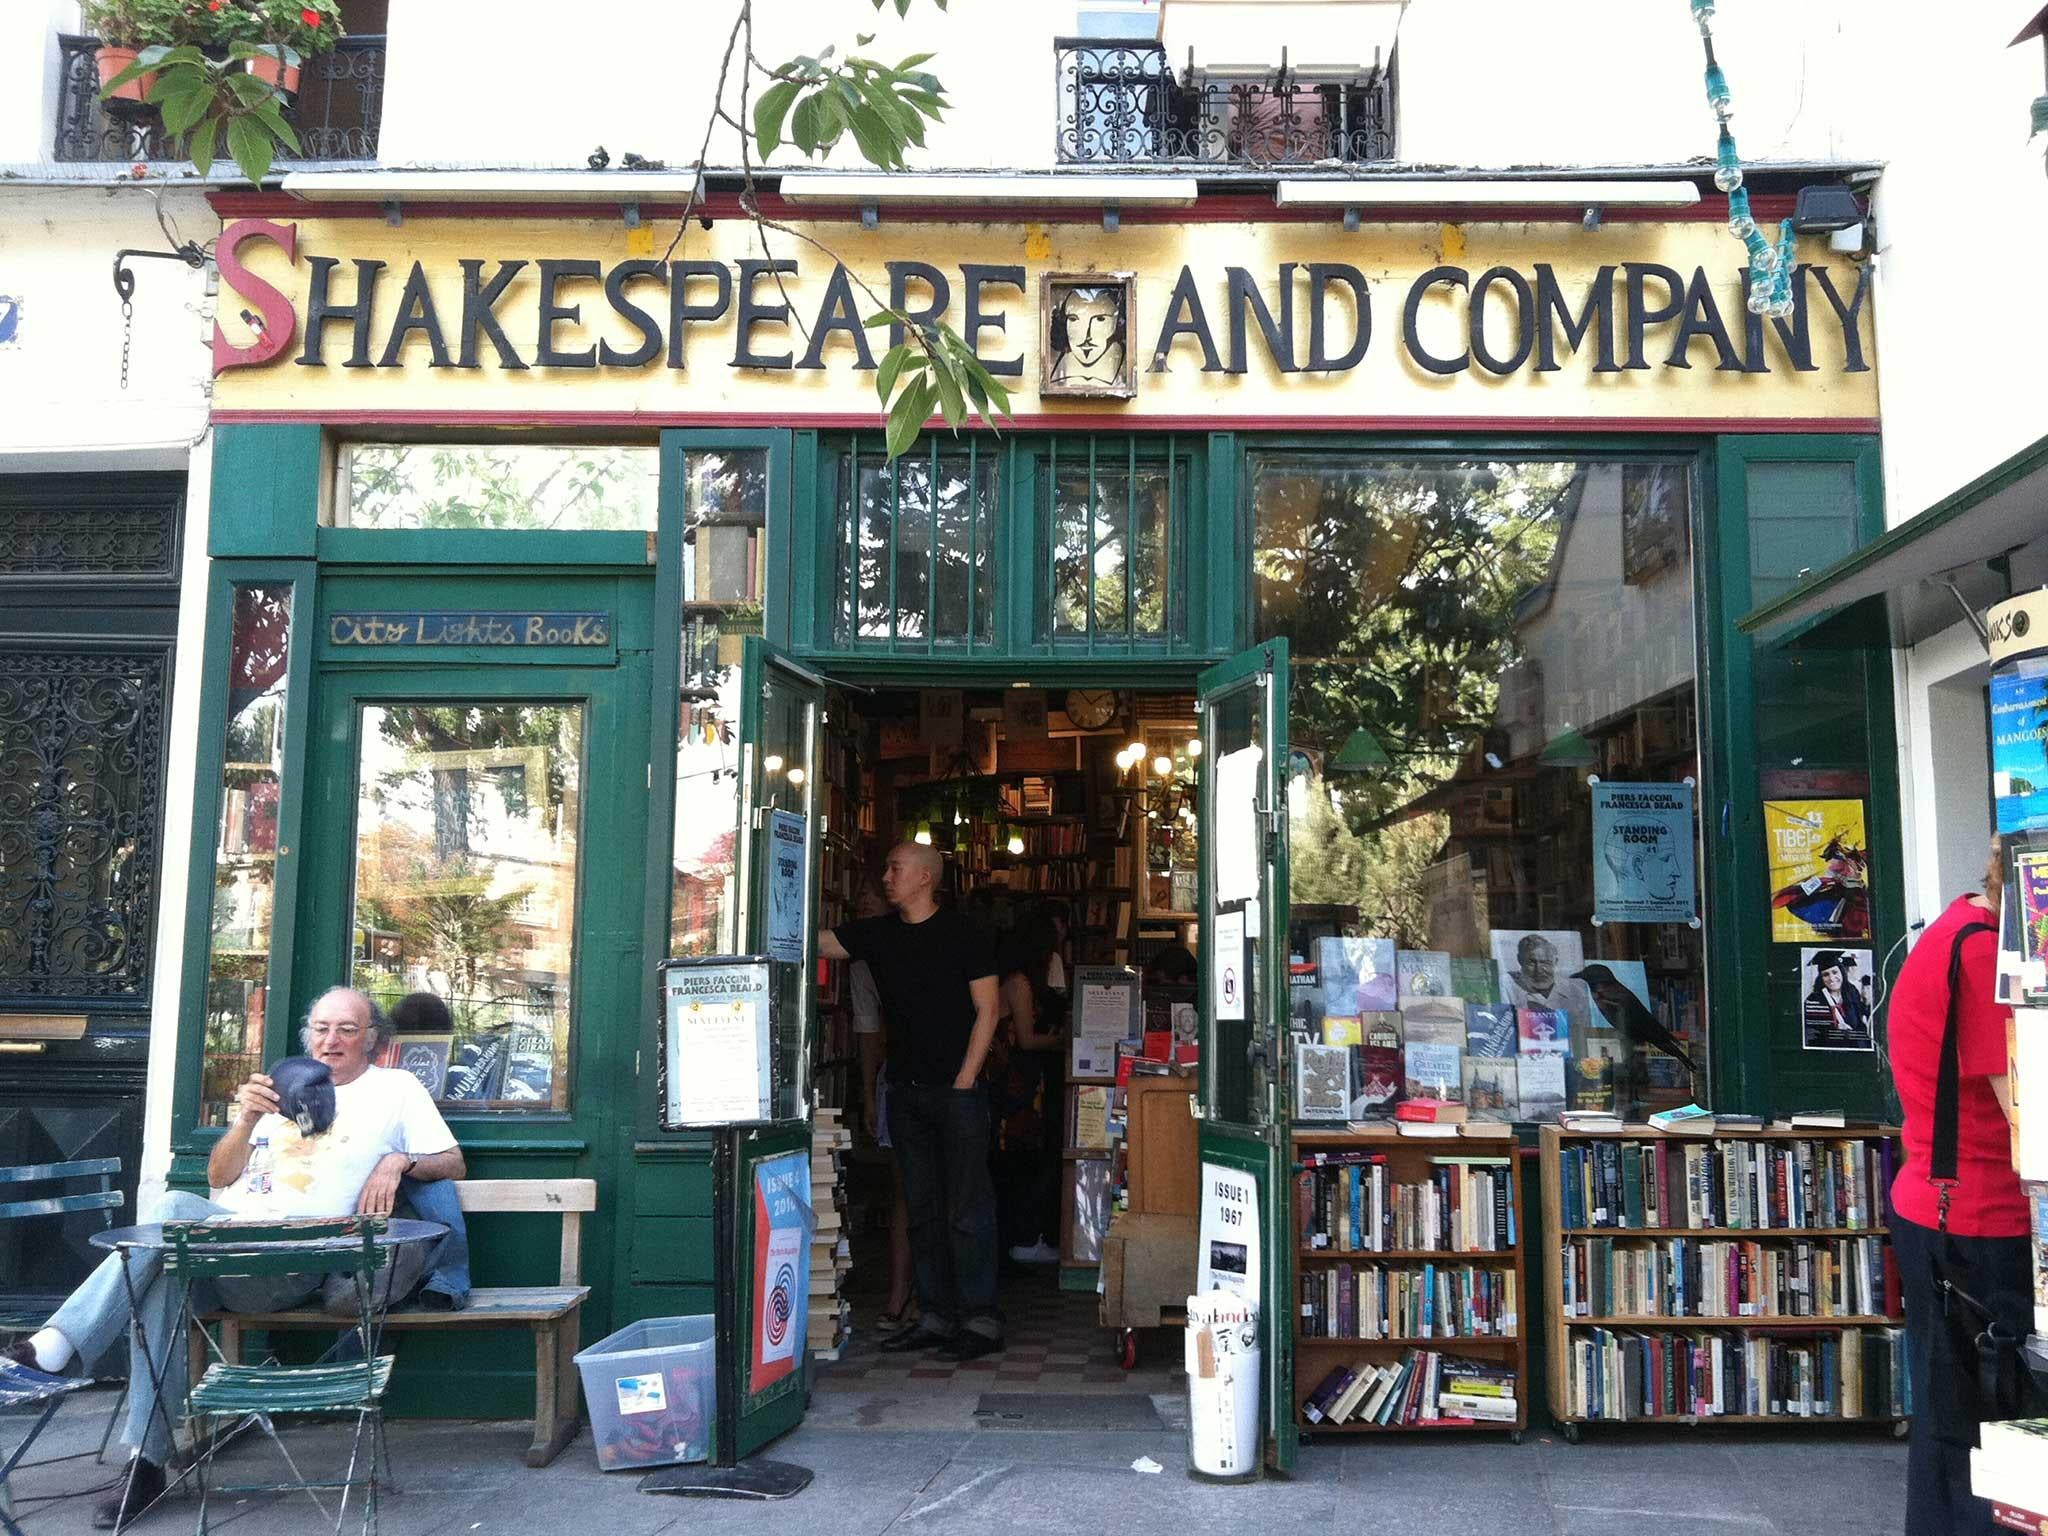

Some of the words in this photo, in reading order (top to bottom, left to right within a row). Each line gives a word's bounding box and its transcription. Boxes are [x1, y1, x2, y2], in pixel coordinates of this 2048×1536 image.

[213, 218, 1026, 377] SHAKESPEARE
[1145, 262, 1372, 374] AND
[1403, 262, 1872, 374] COMPANY
[330, 615, 408, 645] City
[416, 616, 516, 645] Lights
[1611, 794, 1640, 802] PIERS
[1641, 793, 1673, 802] FACCINI
[1600, 802, 1651, 810] FRANCESCA
[1654, 802, 1684, 810] BEARD
[1612, 825, 1668, 835] STANDING
[1773, 828, 1812, 847] TIBET
[1623, 834, 1658, 844] ROOM
[683, 975, 711, 986] PIERS
[712, 974, 750, 985] FACCINI
[671, 983, 728, 996] FRANCESCA
[767, 1171, 794, 1194] ISSUE
[1214, 1180, 1242, 1203] ISSUE
[1244, 1188, 1250, 1205] 1
[1220, 1205, 1243, 1227] 1967
